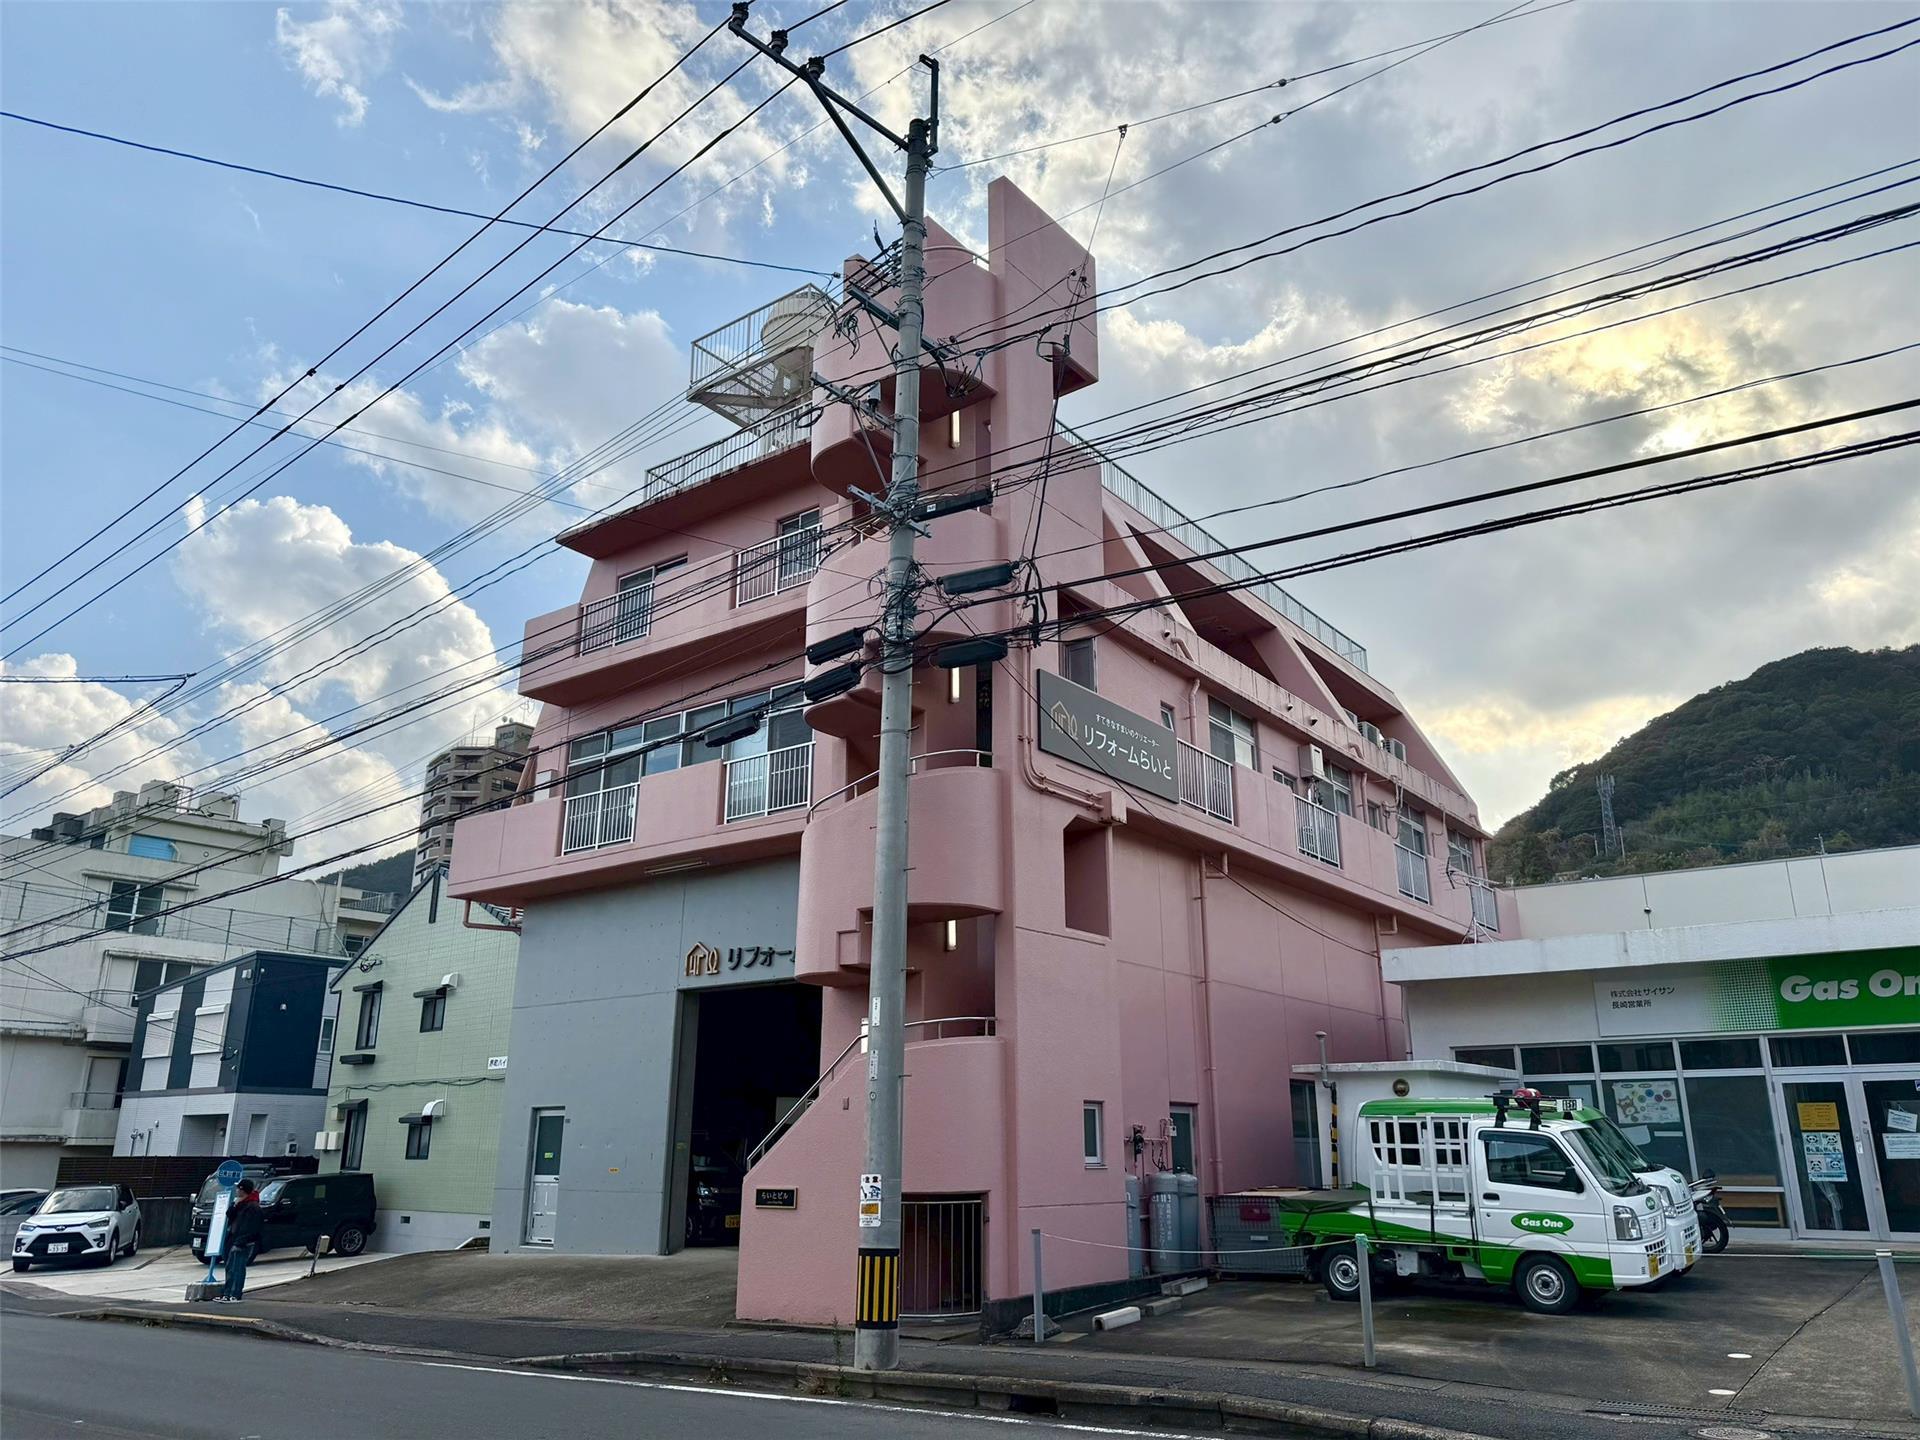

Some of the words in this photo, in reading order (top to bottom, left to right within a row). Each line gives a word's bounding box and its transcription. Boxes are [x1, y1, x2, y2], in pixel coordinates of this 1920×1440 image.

[1083, 724, 1174, 781] リフォームらいと
[727, 946, 796, 971] リフォー
[1610, 987, 1675, 998] 株式会社サイサン
[1780, 974, 1860, 1003] Gas
[1612, 1000, 1652, 1009] 長崎営業所
[1520, 1217, 1541, 1227] Gas
[1542, 1218, 1564, 1228] One
